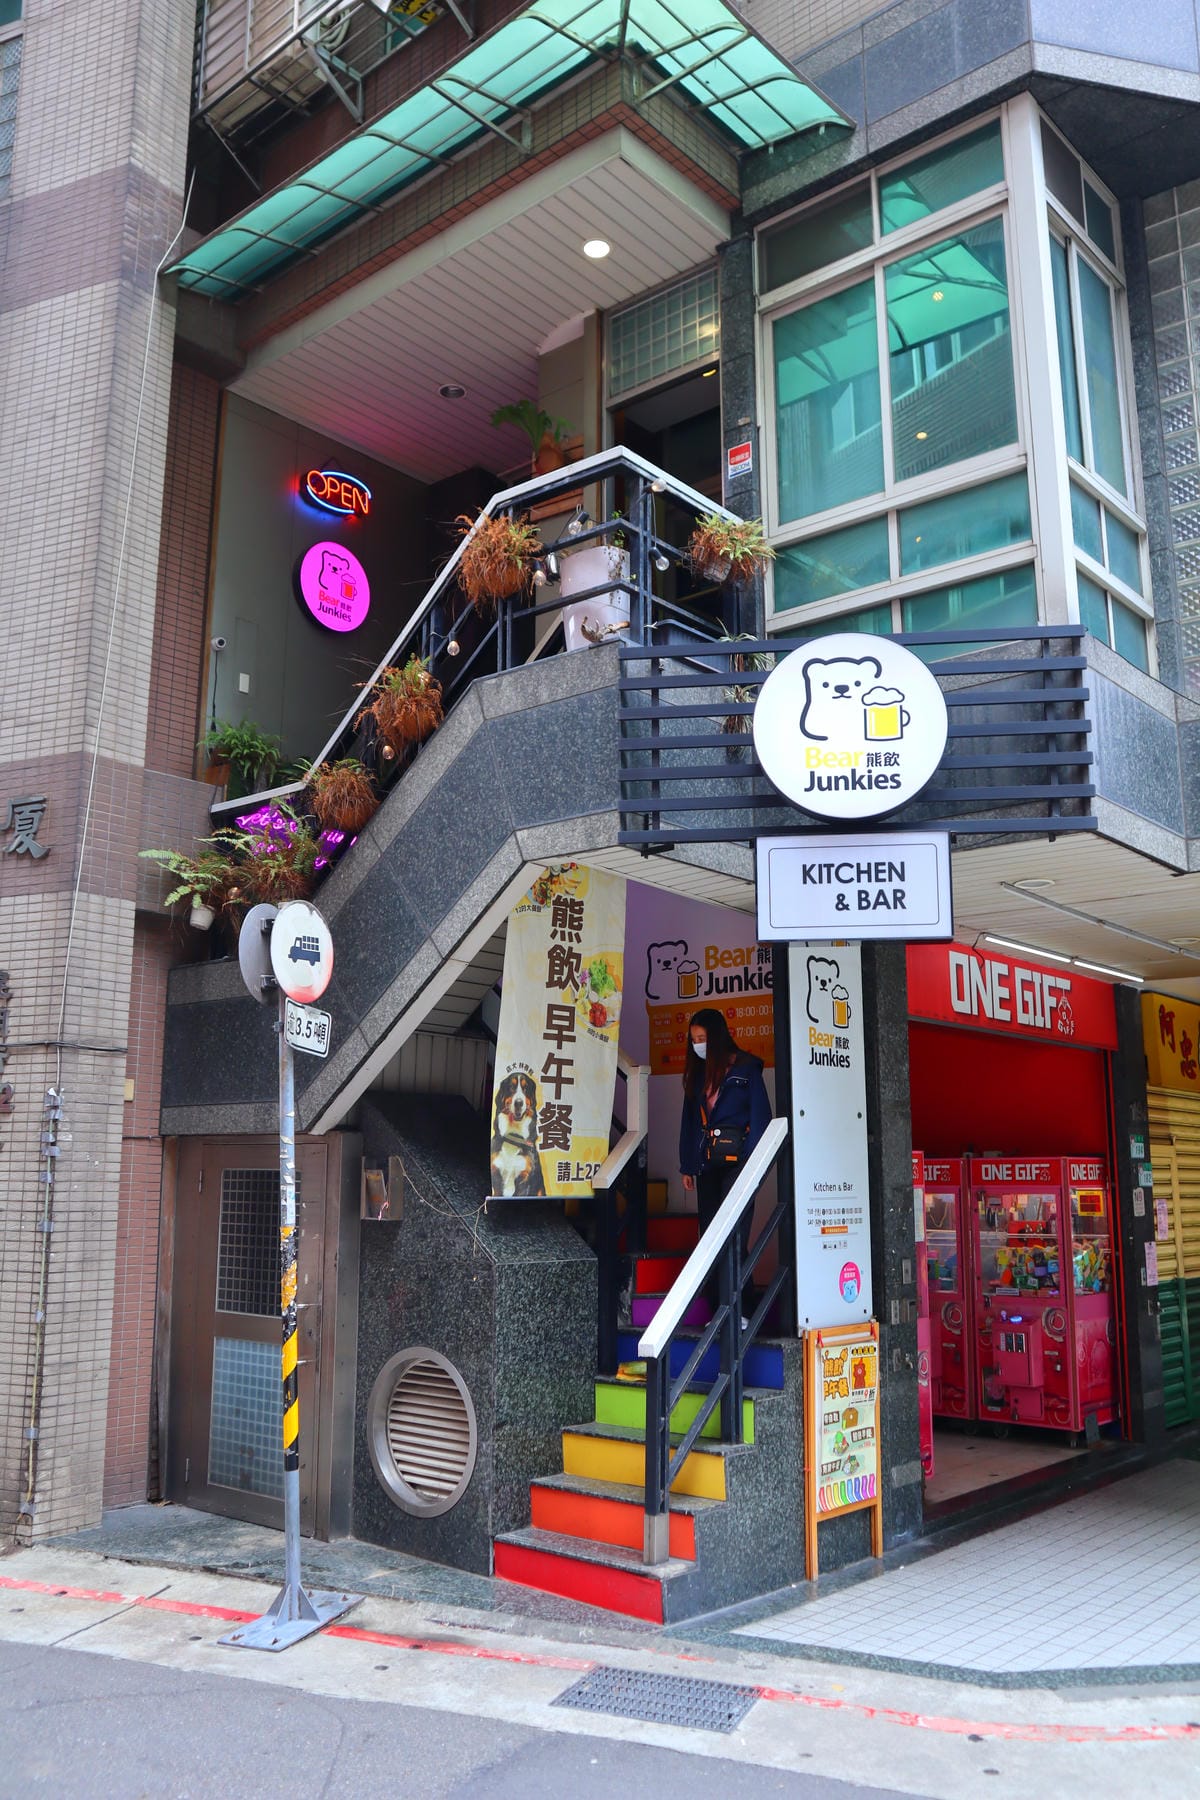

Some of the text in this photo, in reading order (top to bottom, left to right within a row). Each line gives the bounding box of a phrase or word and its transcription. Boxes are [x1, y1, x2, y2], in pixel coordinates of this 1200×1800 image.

[307, 470, 369, 514] OPEN
[319, 590, 340, 607] Bear
[317, 602, 352, 622] Junkies
[804, 746, 900, 769] Bear 熊飲
[804, 769, 902, 792] Junkies
[802, 861, 906, 885] KITCHEN
[835, 889, 907, 912] & BAR
[704, 945, 774, 971] Bear 熊
[704, 967, 774, 996] Junkie
[949, 951, 1071, 1029] ONE GIFT
[537, 894, 585, 1152] 熊飲 早午餐
[808, 1026, 834, 1047] Bear
[809, 1047, 850, 1068] Junkies
[982, 1163, 1050, 1181] ONE GIFT
[1071, 1163, 1087, 1181] ONE
[814, 1182, 837, 1192] Kitchen
[843, 1182, 853, 1192] Bar
